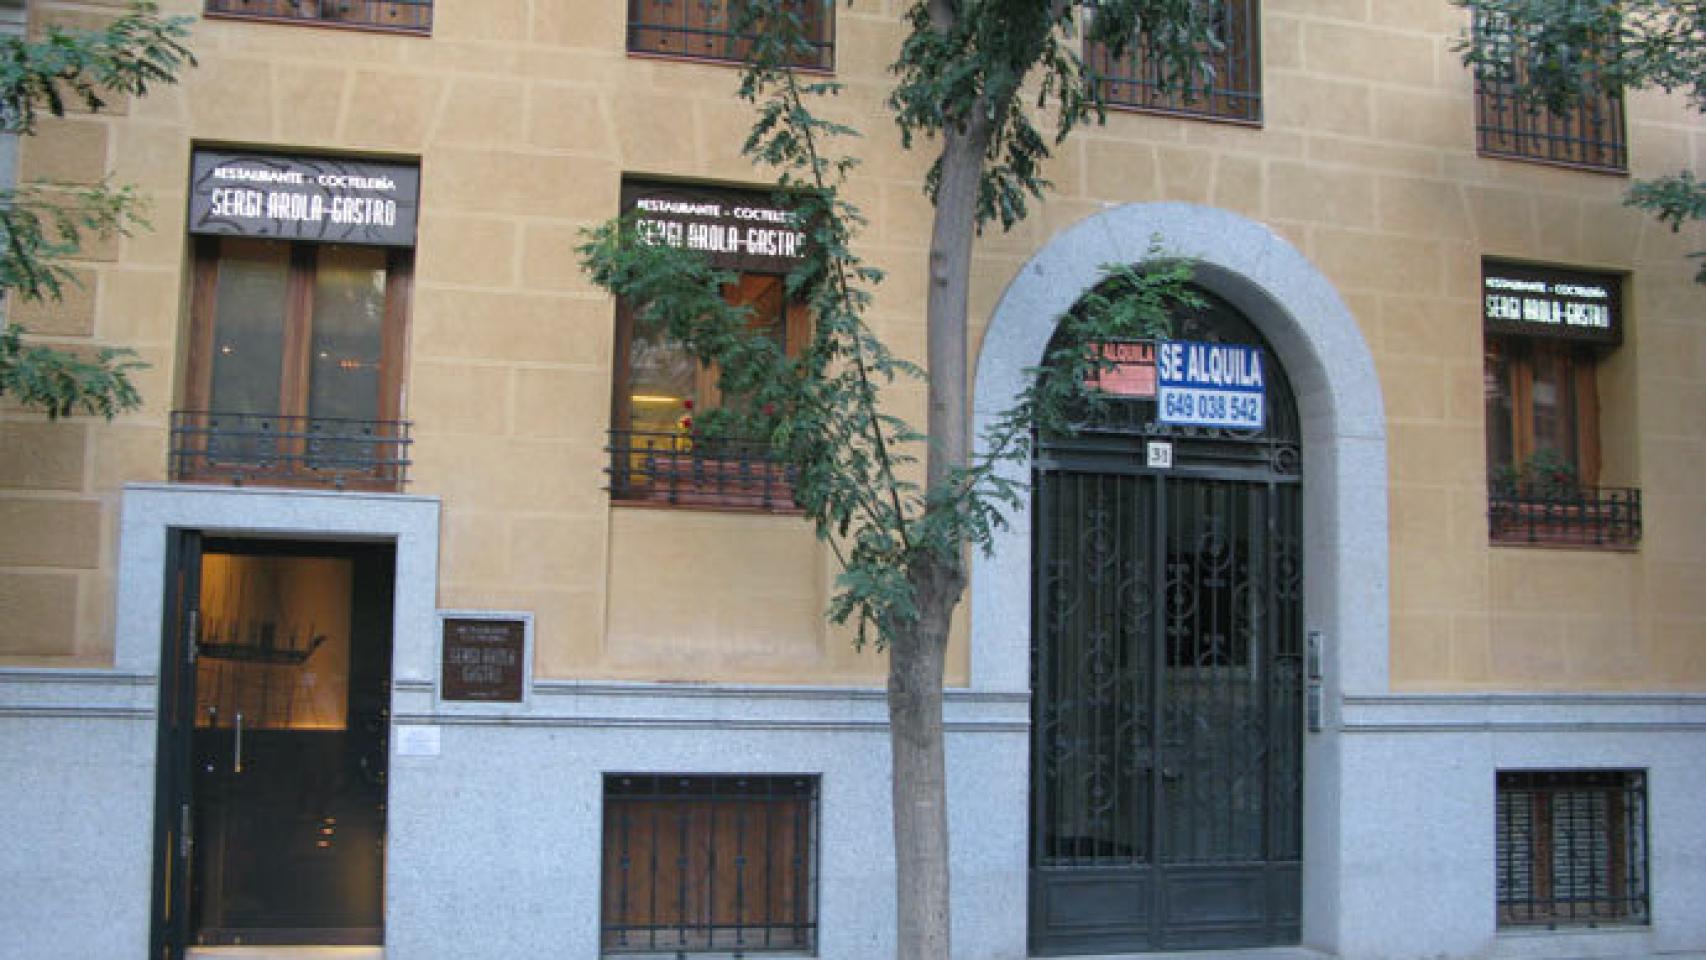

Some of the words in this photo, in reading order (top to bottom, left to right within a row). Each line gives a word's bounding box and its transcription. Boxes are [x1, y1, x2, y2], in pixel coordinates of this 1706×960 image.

[213, 167, 303, 184] RESTAURANTE
[212, 188, 262, 217] SERGI
[266, 191, 396, 226] AROLA-GASTRO
[1485, 294, 1521, 319] SERGI
[1161, 343, 1183, 381] SE
[1186, 346, 1262, 386] ALQUILA
[1166, 392, 1194, 417] 649
[1230, 396, 1257, 421] 542
[1151, 447, 1168, 464] 31
